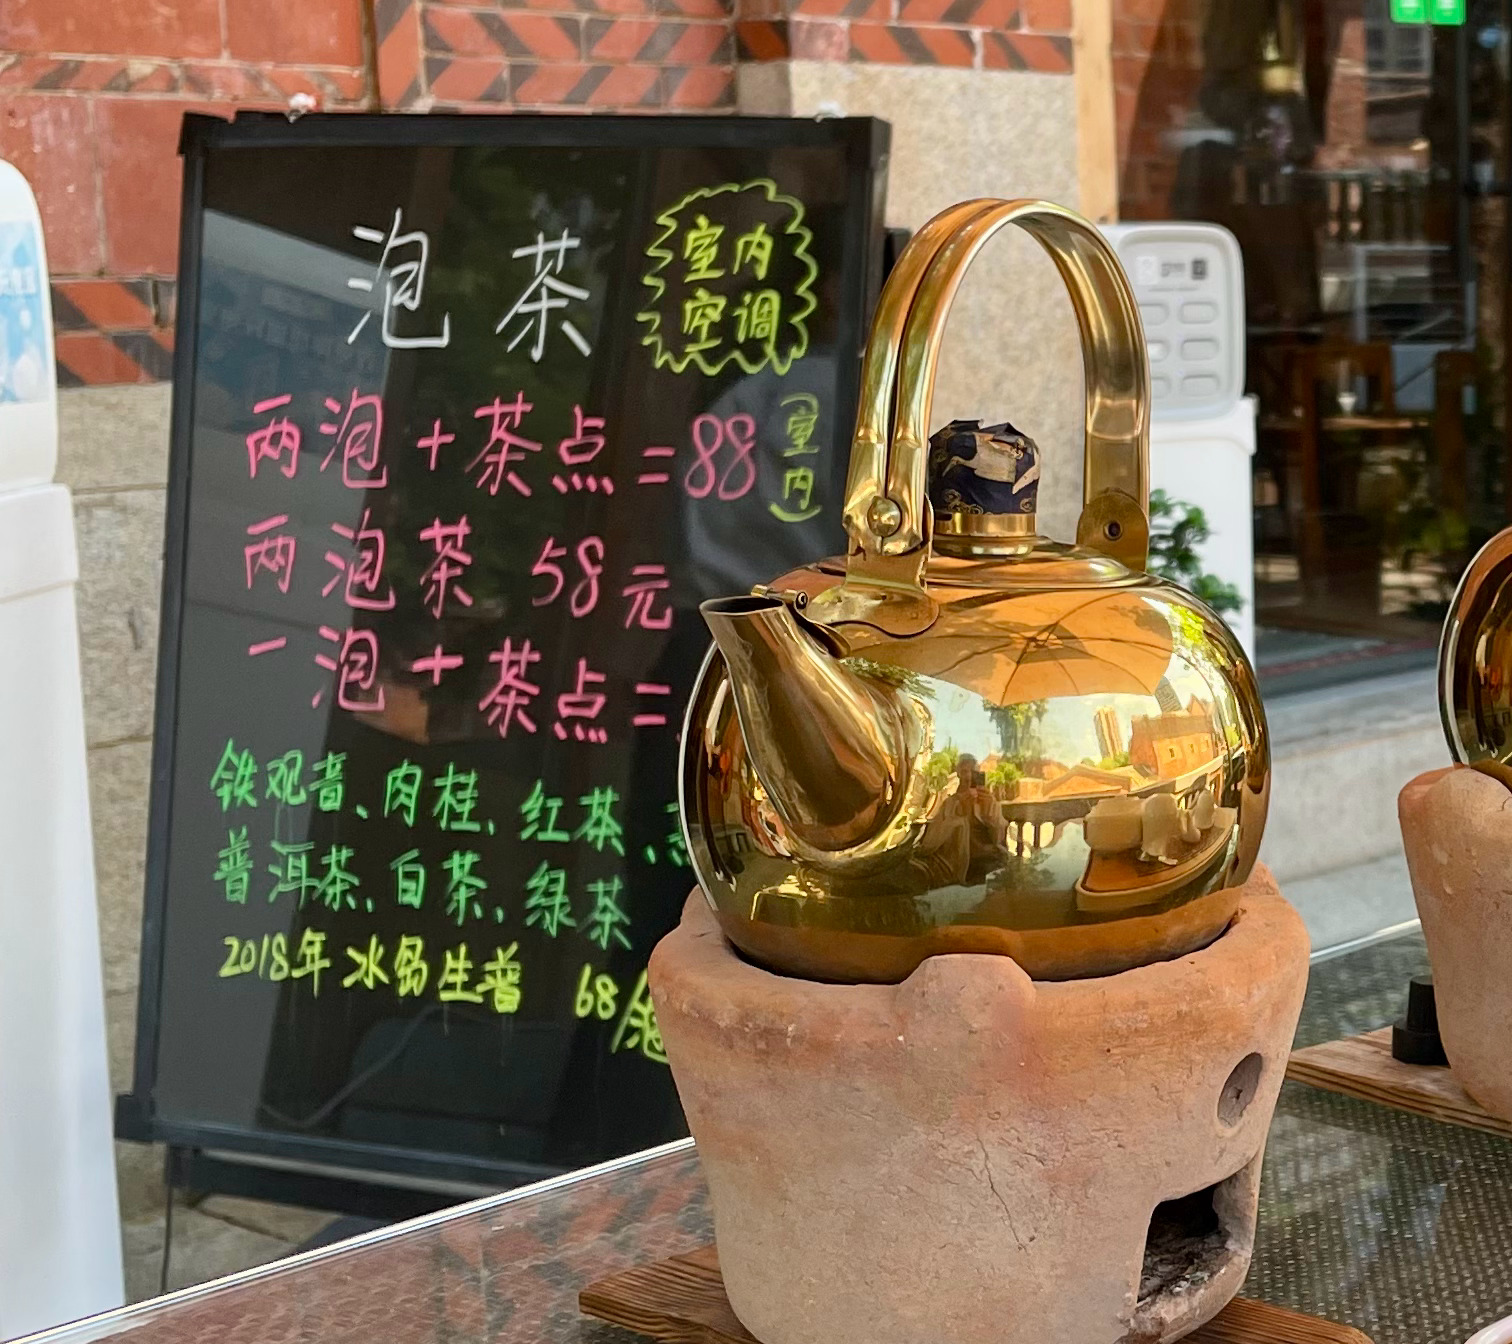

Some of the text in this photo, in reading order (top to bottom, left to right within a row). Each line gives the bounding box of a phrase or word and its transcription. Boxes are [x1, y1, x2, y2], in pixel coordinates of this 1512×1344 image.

[682, 214, 775, 284] 室内
[347, 208, 591, 362] 泡茶
[681, 288, 781, 356] 空调
